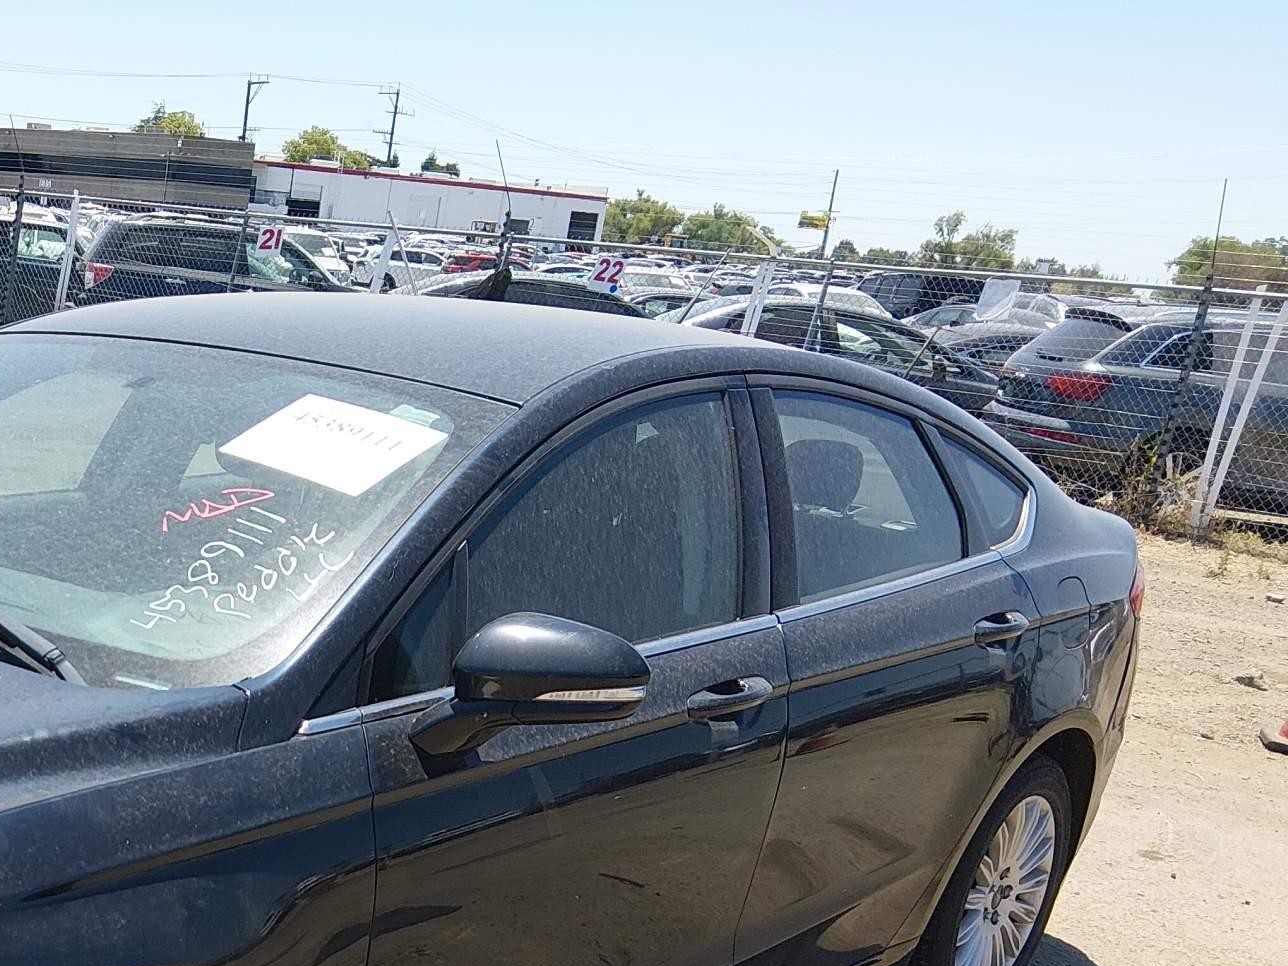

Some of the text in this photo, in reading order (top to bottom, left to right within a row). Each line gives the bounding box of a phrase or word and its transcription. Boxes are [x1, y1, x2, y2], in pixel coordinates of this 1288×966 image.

[258, 228, 283, 250] 21
[593, 258, 625, 284] 22
[129, 505, 287, 630] 45389111
